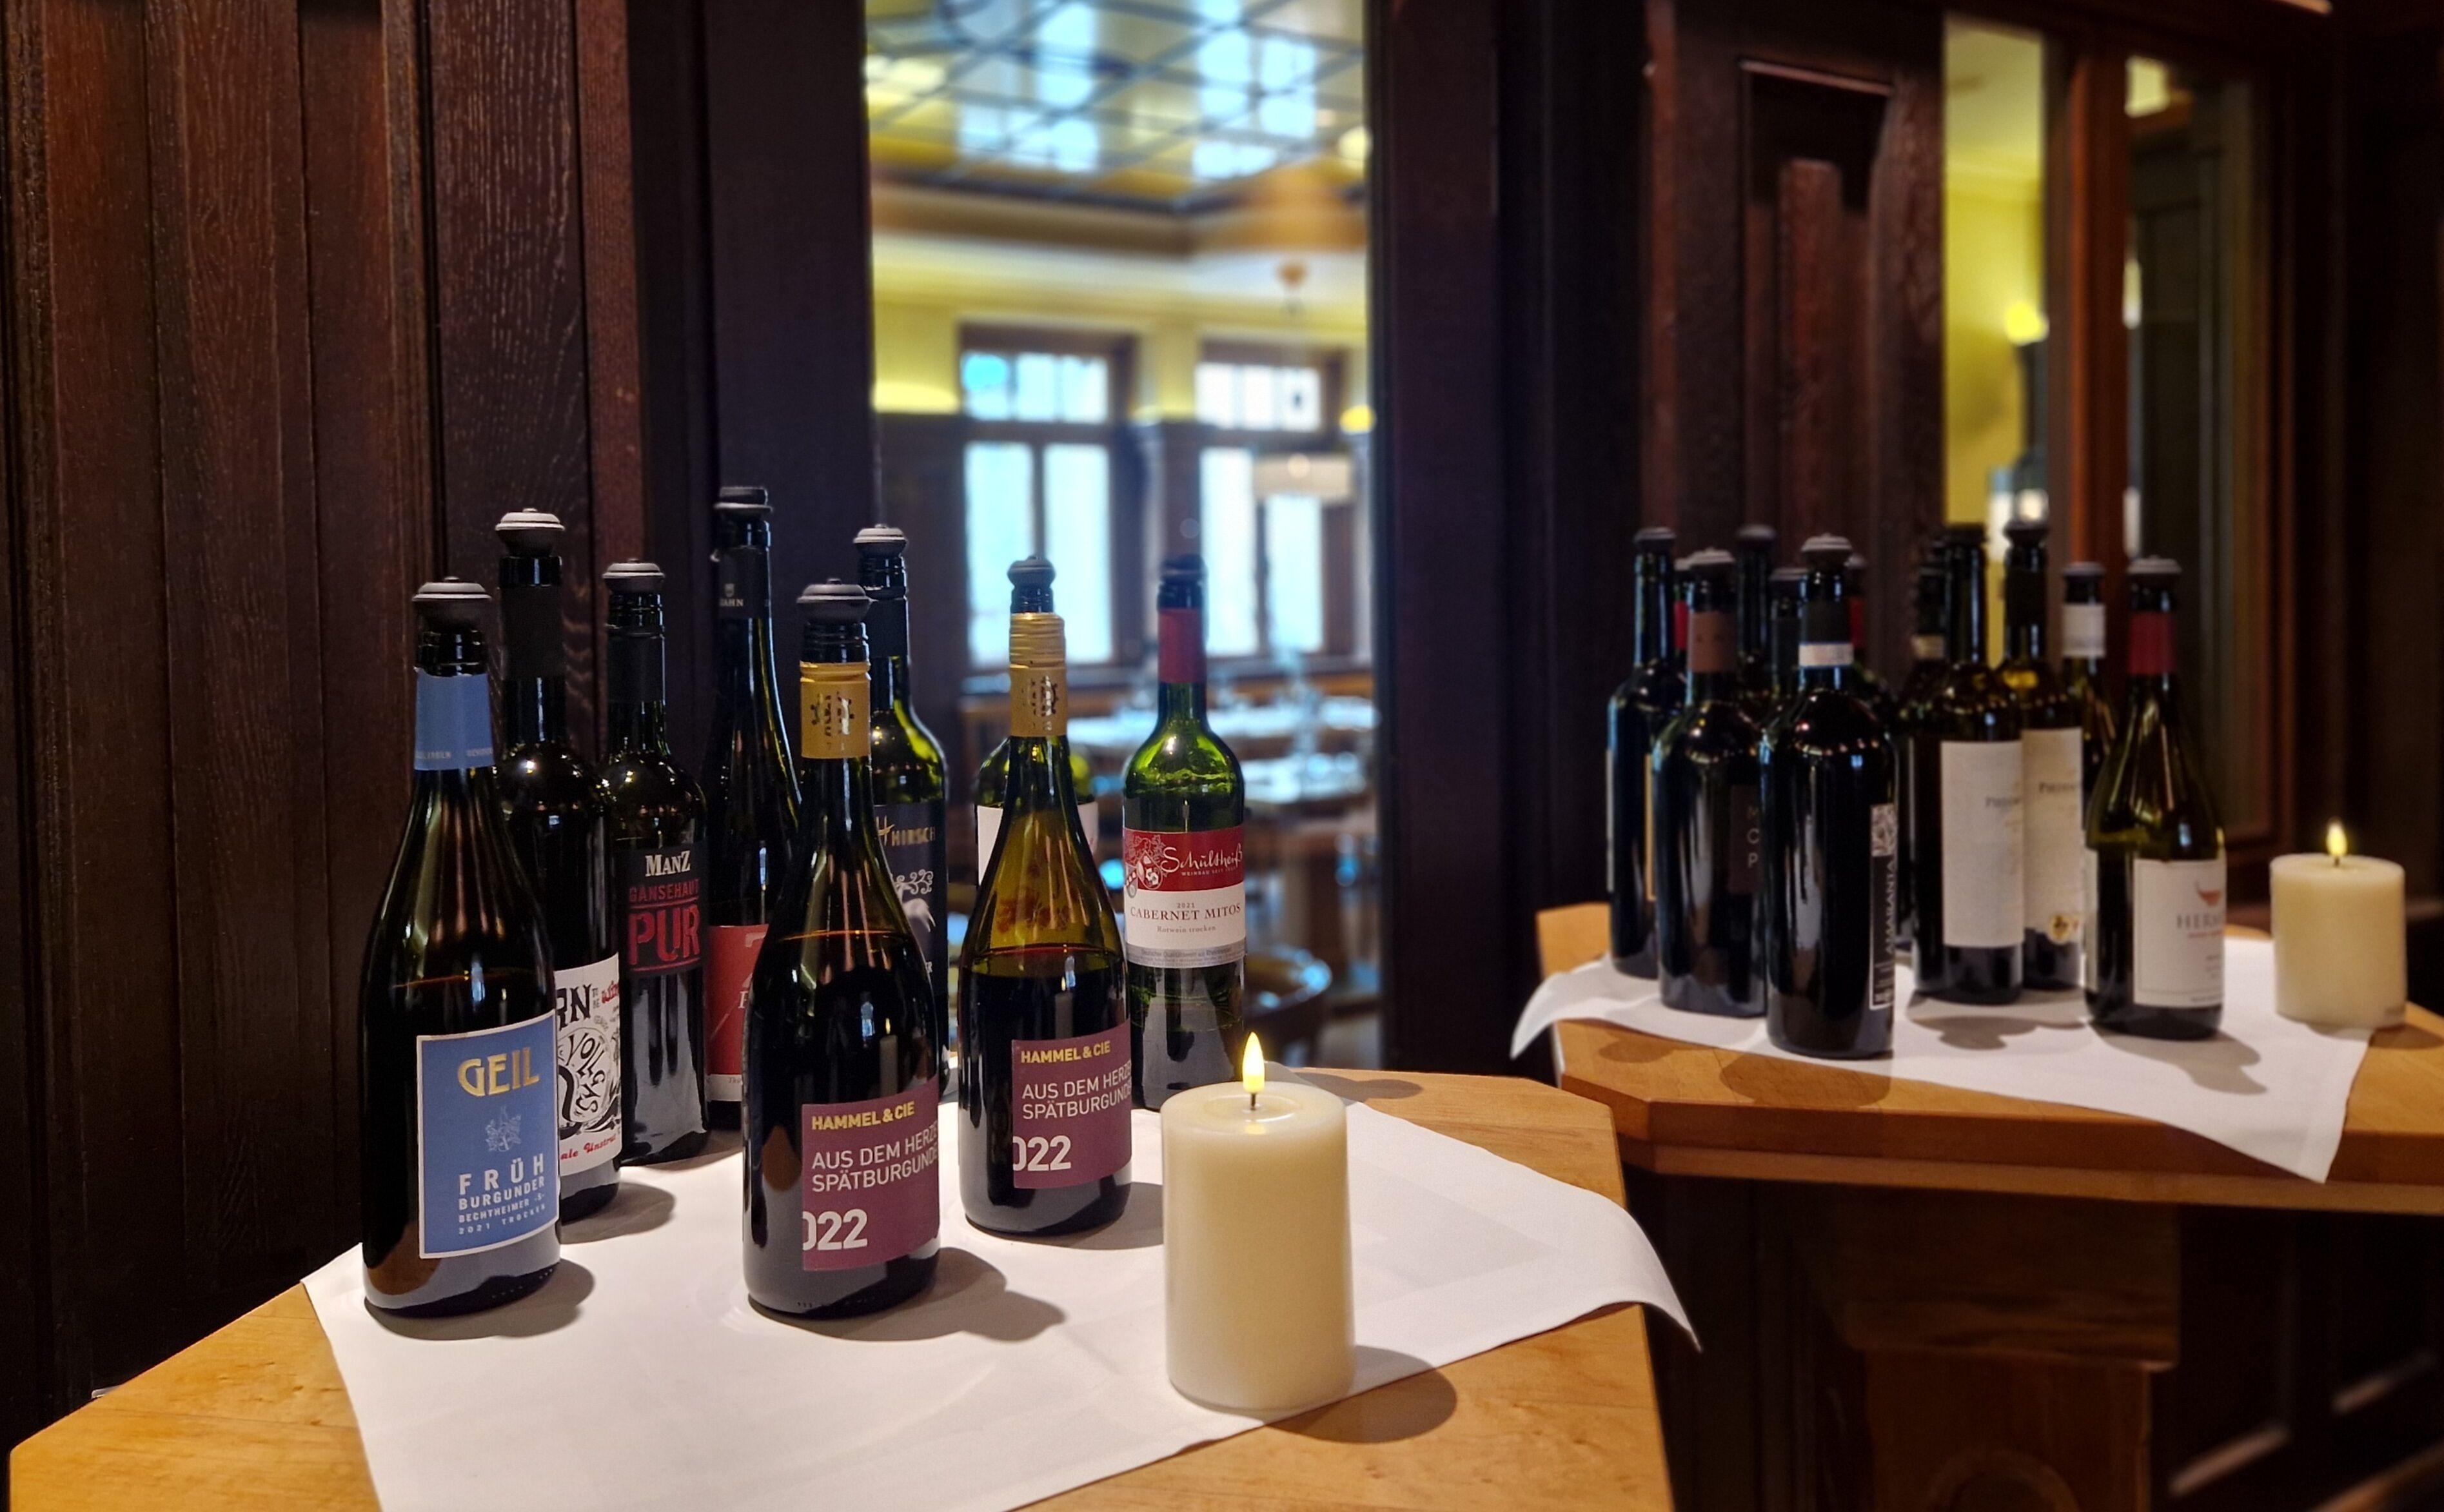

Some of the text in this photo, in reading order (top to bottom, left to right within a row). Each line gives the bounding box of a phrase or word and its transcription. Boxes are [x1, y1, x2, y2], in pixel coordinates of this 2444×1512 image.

[1130, 903, 1241, 921] CABERNET MITOS
[628, 904, 700, 965] PUR
[1157, 925, 1217, 934] Rotwein trocken
[1021, 1049, 1081, 1064] HAMMEL
[1093, 1040, 1111, 1057] CIE
[457, 1046, 540, 1097] GEIL
[1021, 1083, 1059, 1099] AUS
[1064, 1076, 1099, 1097] DEM
[812, 1111, 882, 1130] HAMMEL
[894, 1101, 915, 1119] CIE
[812, 1150, 854, 1170] AUS
[860, 1141, 900, 1166] DEM
[459, 1153, 544, 1195] FRÜH
[458, 1176, 545, 1210] BURGUNDER
[458, 1199, 530, 1223] BECHTHEIMER
[458, 1203, 546, 1235] 2021 TROCKEN
